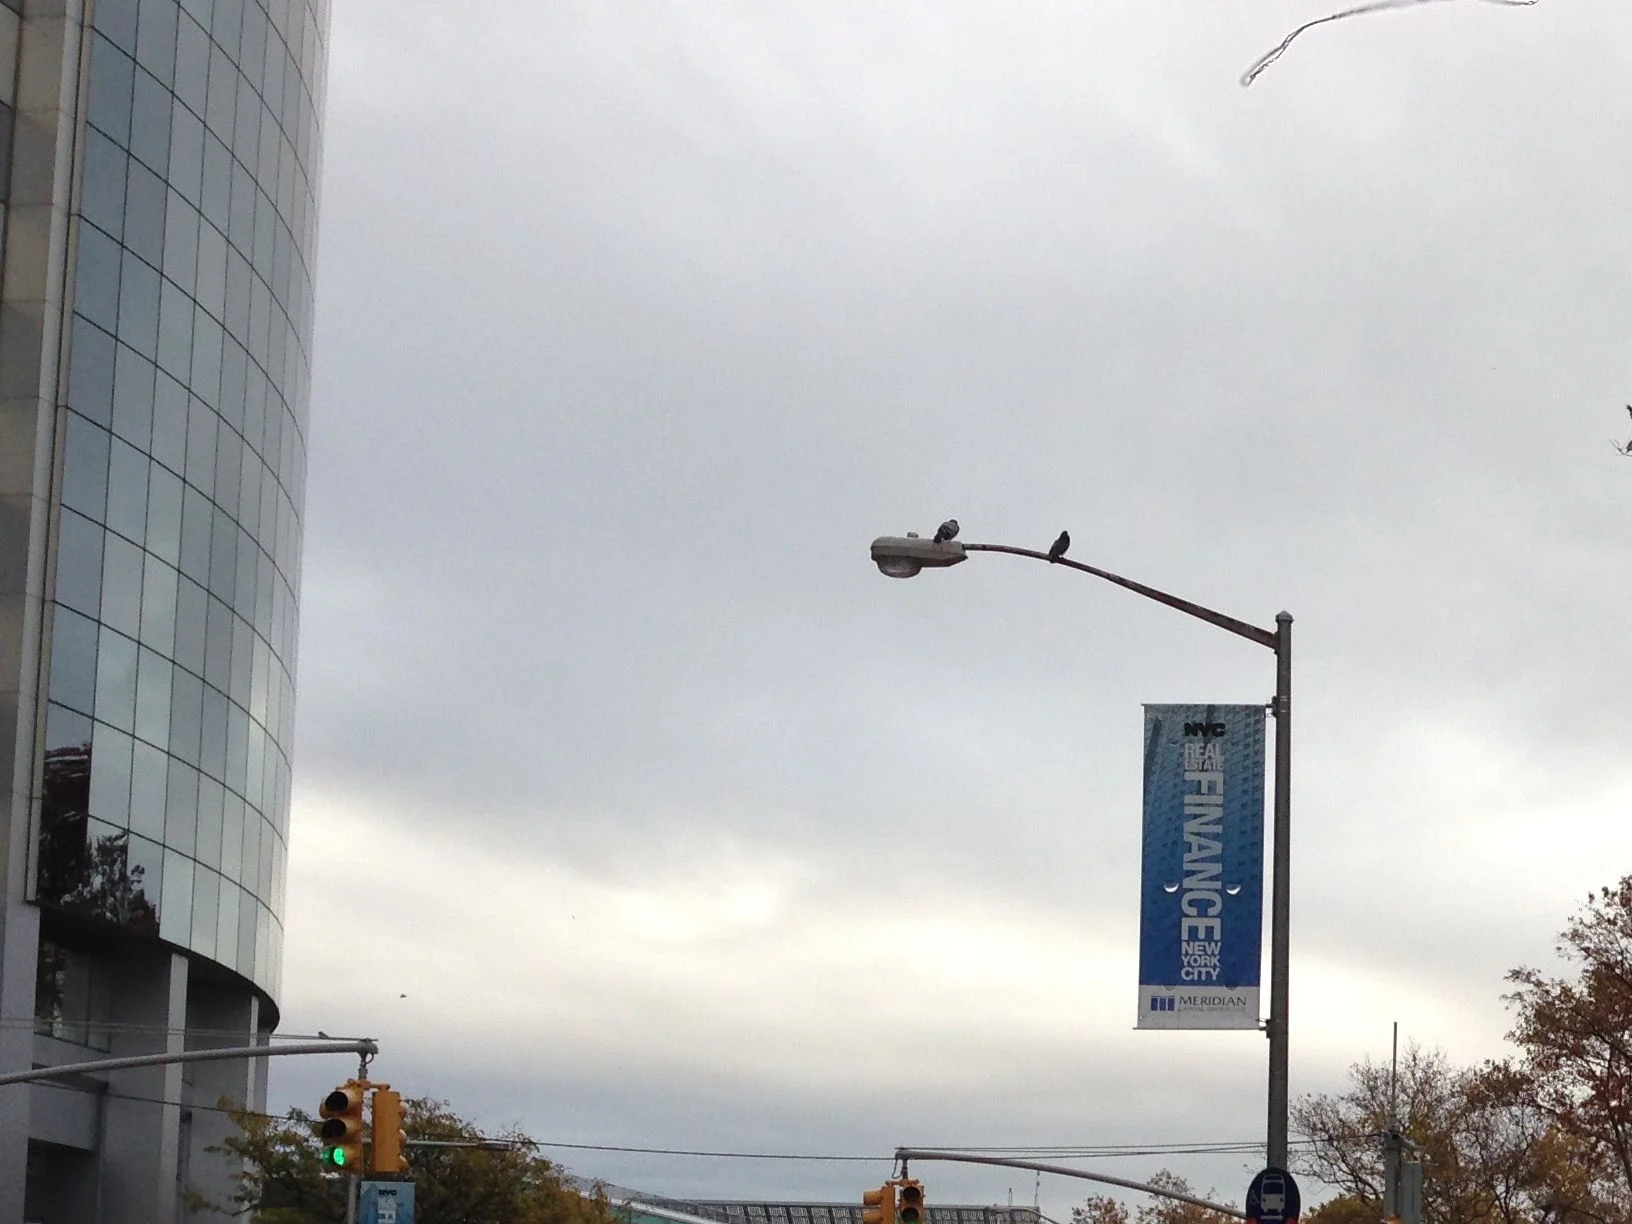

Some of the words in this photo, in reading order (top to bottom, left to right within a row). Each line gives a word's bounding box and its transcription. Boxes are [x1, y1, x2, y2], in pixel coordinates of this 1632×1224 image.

[1183, 722, 1226, 737] NYC
[1184, 743, 1225, 759] REAL
[1184, 759, 1225, 771] ESTATE
[1181, 771, 1225, 941] FINANCE
[1181, 941, 1222, 955] NEW
[1181, 955, 1220, 968] YORK
[1180, 967, 1221, 981] CITY
[1178, 996, 1247, 1006] MERIDIAN
